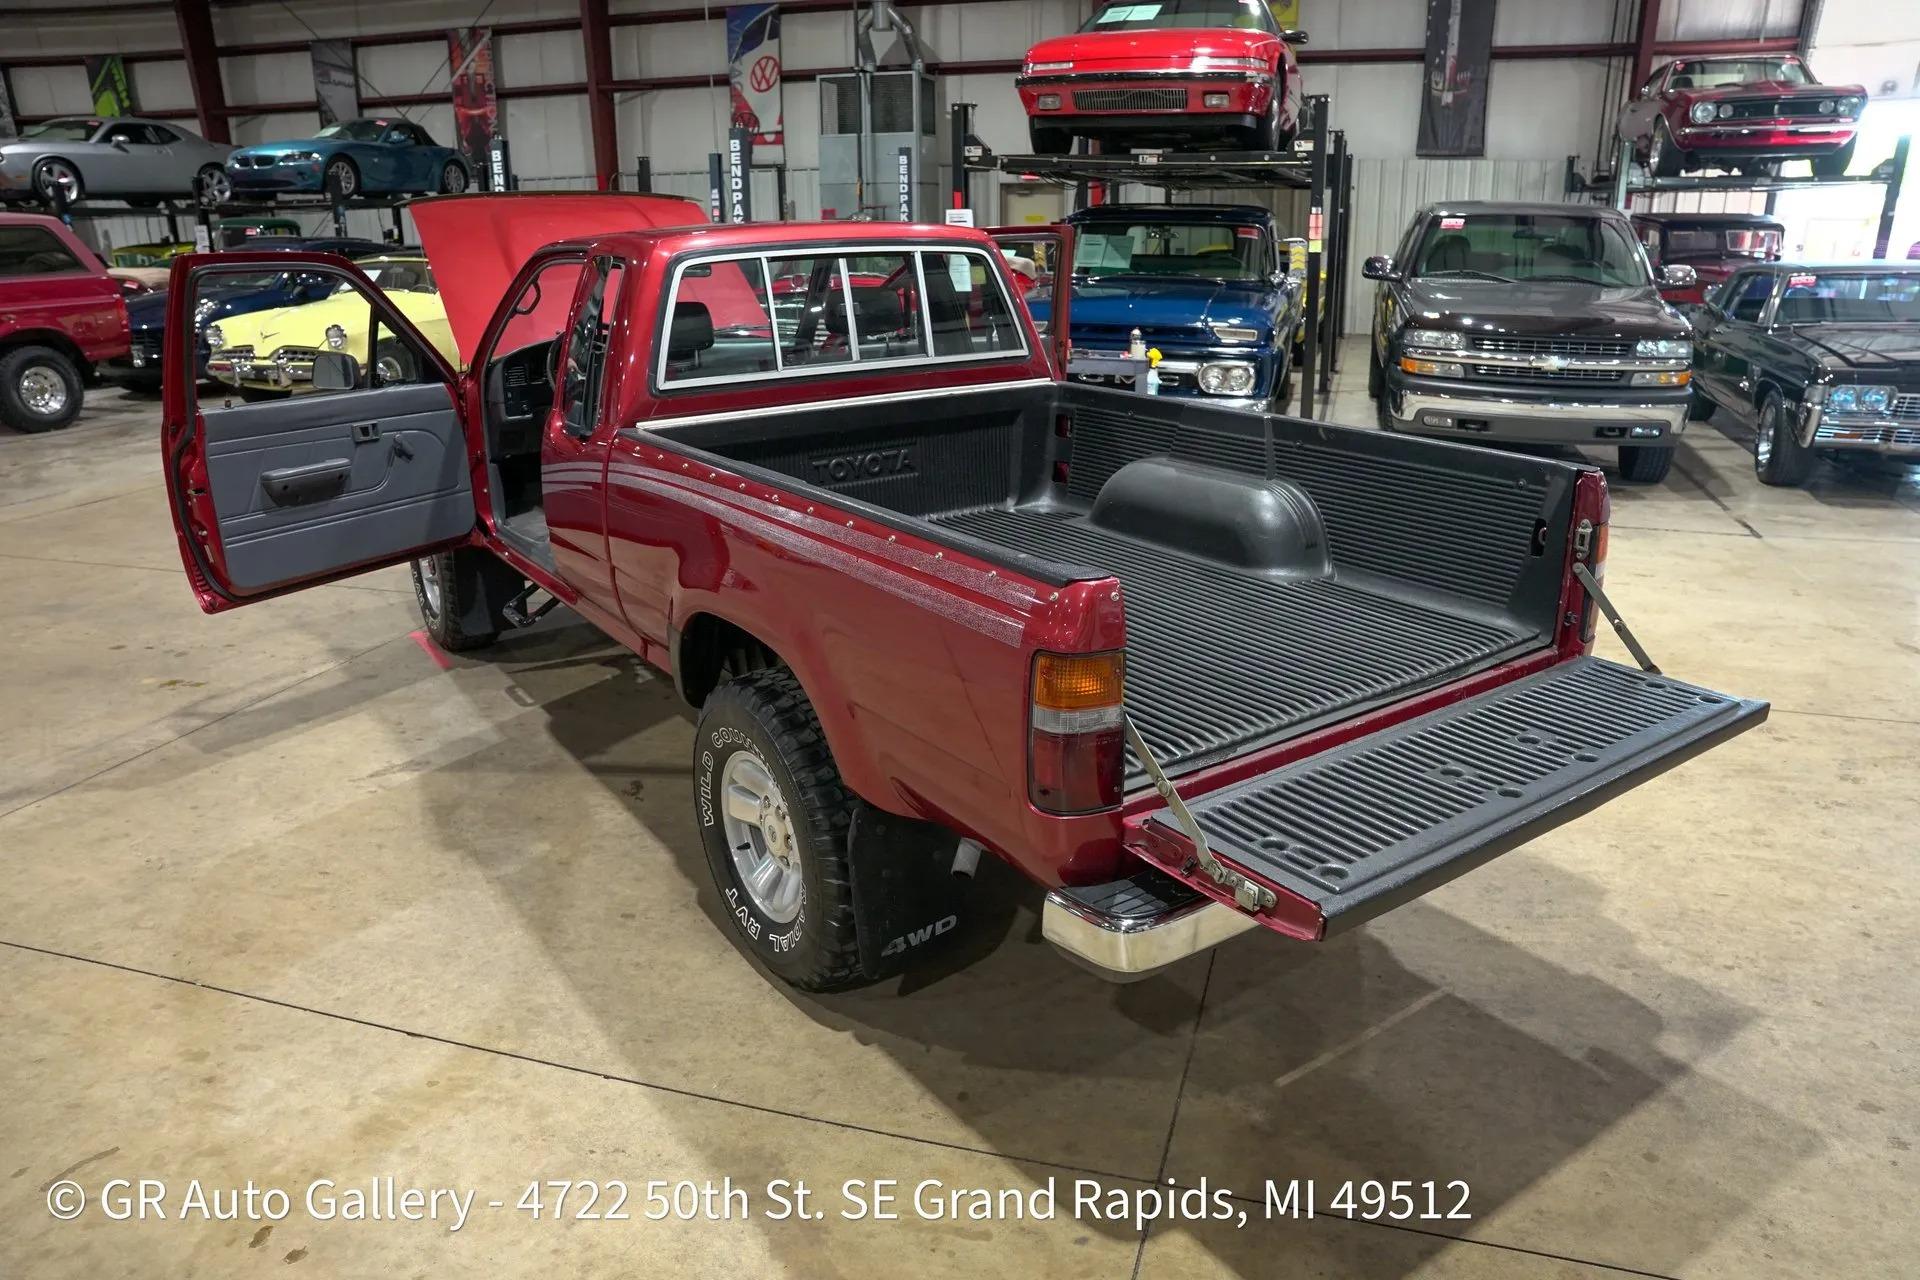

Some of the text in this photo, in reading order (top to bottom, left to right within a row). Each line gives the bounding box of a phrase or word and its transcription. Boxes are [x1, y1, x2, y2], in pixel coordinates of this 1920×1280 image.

[730, 140, 744, 224] BENDPAK
[899, 155, 909, 222] BENDPAK
[811, 449, 918, 479] TOYOTA
[701, 750, 714, 827] WILD
[724, 888, 761, 941] RVT
[881, 914, 957, 957] 4WD
